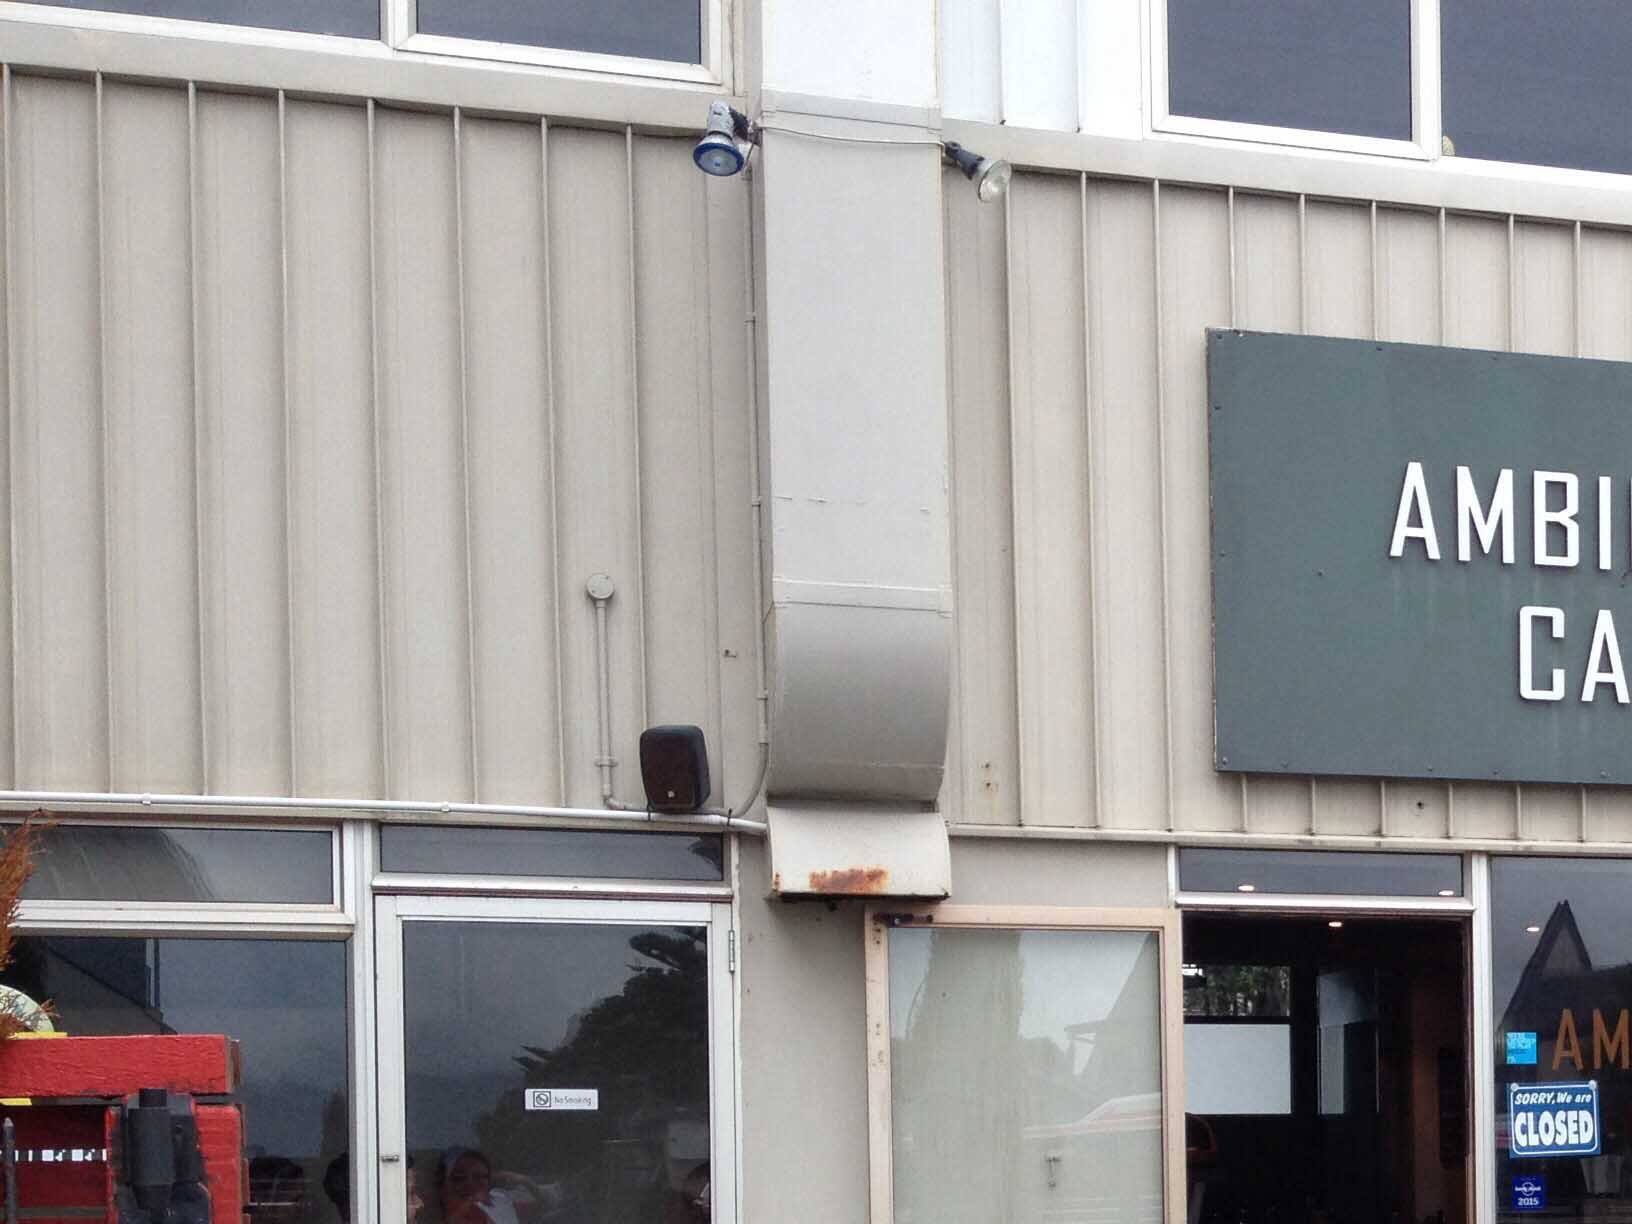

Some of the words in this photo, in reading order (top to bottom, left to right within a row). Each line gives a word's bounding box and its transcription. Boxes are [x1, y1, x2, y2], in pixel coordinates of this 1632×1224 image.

[1514, 1091, 1555, 1105] SORRY,
[1556, 1091, 1573, 1104] We
[1574, 1094, 1593, 1104] are
[1514, 1110, 1594, 1147] CLOSED
